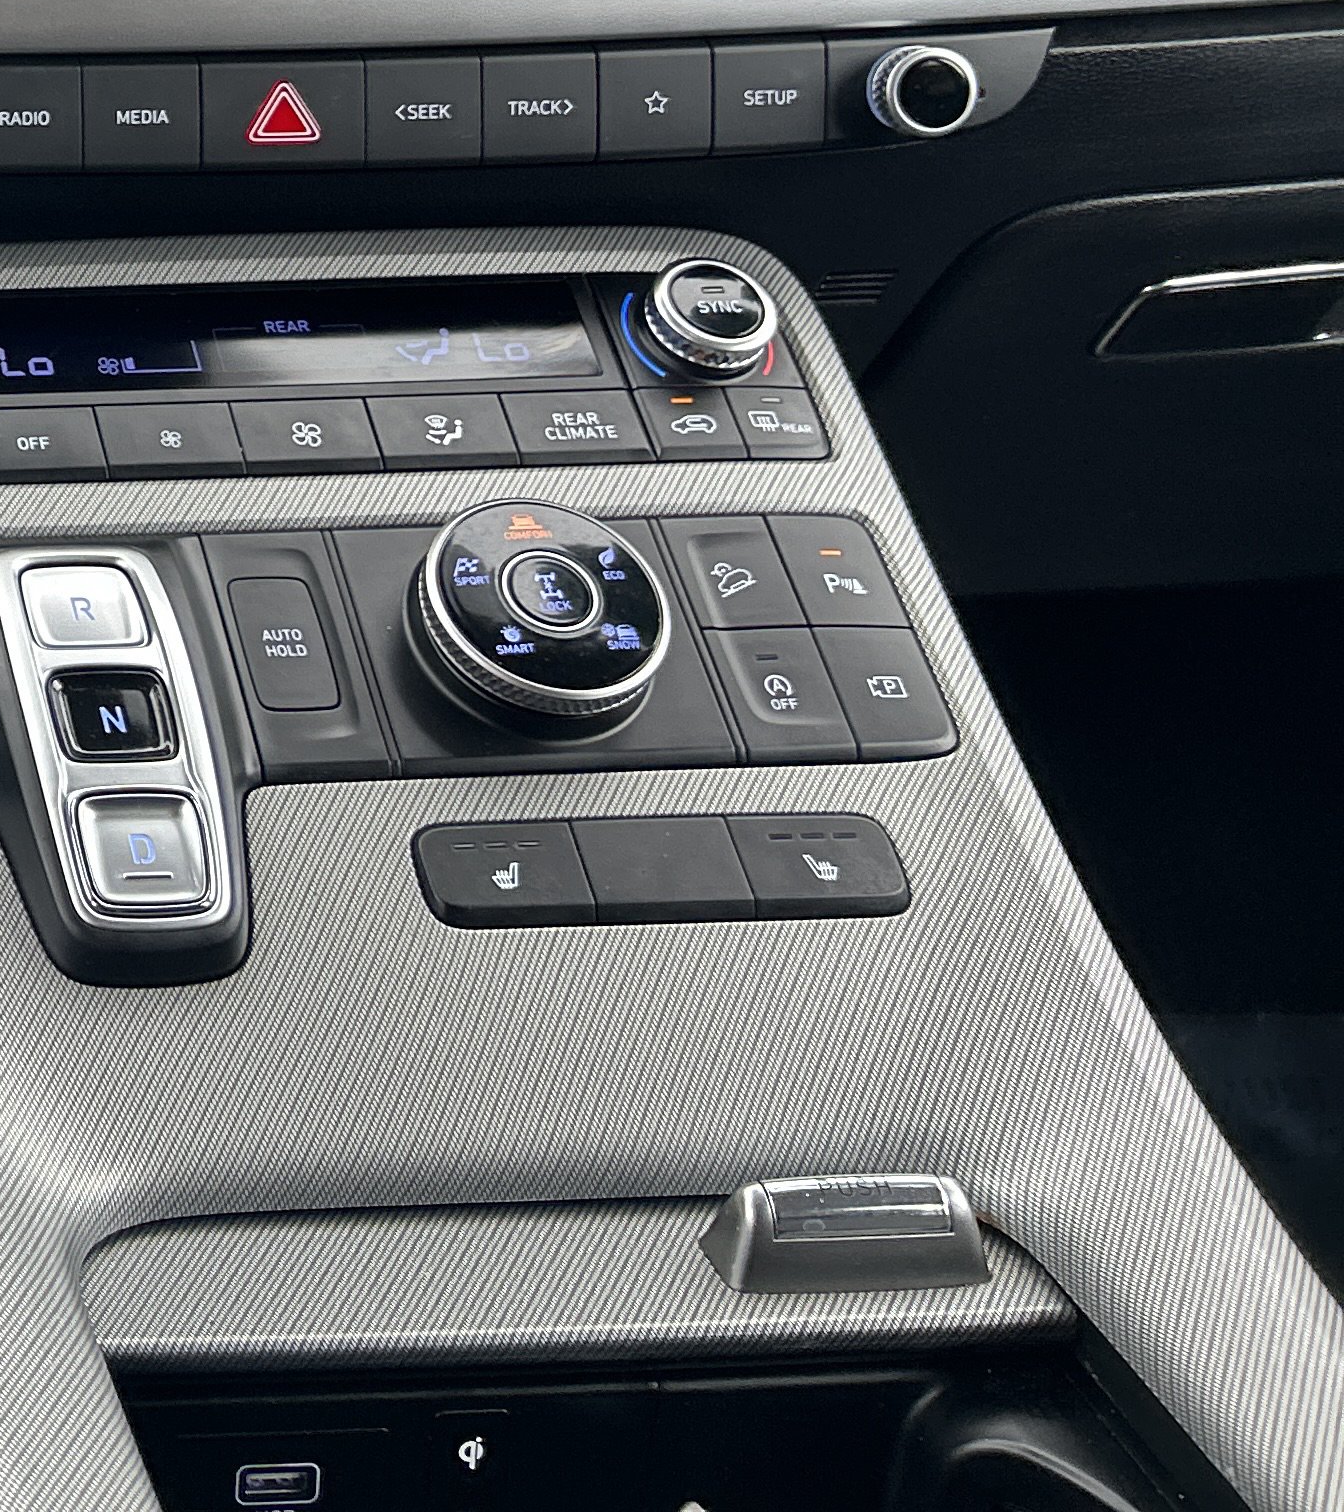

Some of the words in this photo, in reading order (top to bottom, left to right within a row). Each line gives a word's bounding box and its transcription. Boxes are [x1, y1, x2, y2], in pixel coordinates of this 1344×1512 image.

[744, 90, 797, 105] SETUP
[0, 111, 49, 125] RADIO
[117, 110, 169, 124] MEDIA
[697, 300, 743, 315] SYNC
[264, 320, 310, 333] REAR
[552, 412, 601, 427] REAR
[545, 424, 618, 440] CLIMATE
[781, 423, 813, 433] REAR
[17, 437, 49, 450] OFF
[453, 575, 489, 587] SPORT
[603, 571, 625, 580] ECO
[70, 597, 95, 624] R
[539, 600, 573, 613] LOCK
[263, 629, 302, 641] AUTO
[265, 644, 307, 656] HOLD
[496, 643, 534, 655] SMART
[607, 640, 640, 650] SNOW
[771, 698, 797, 710] OFF
[99, 706, 127, 733] N
[128, 833, 155, 865] D
